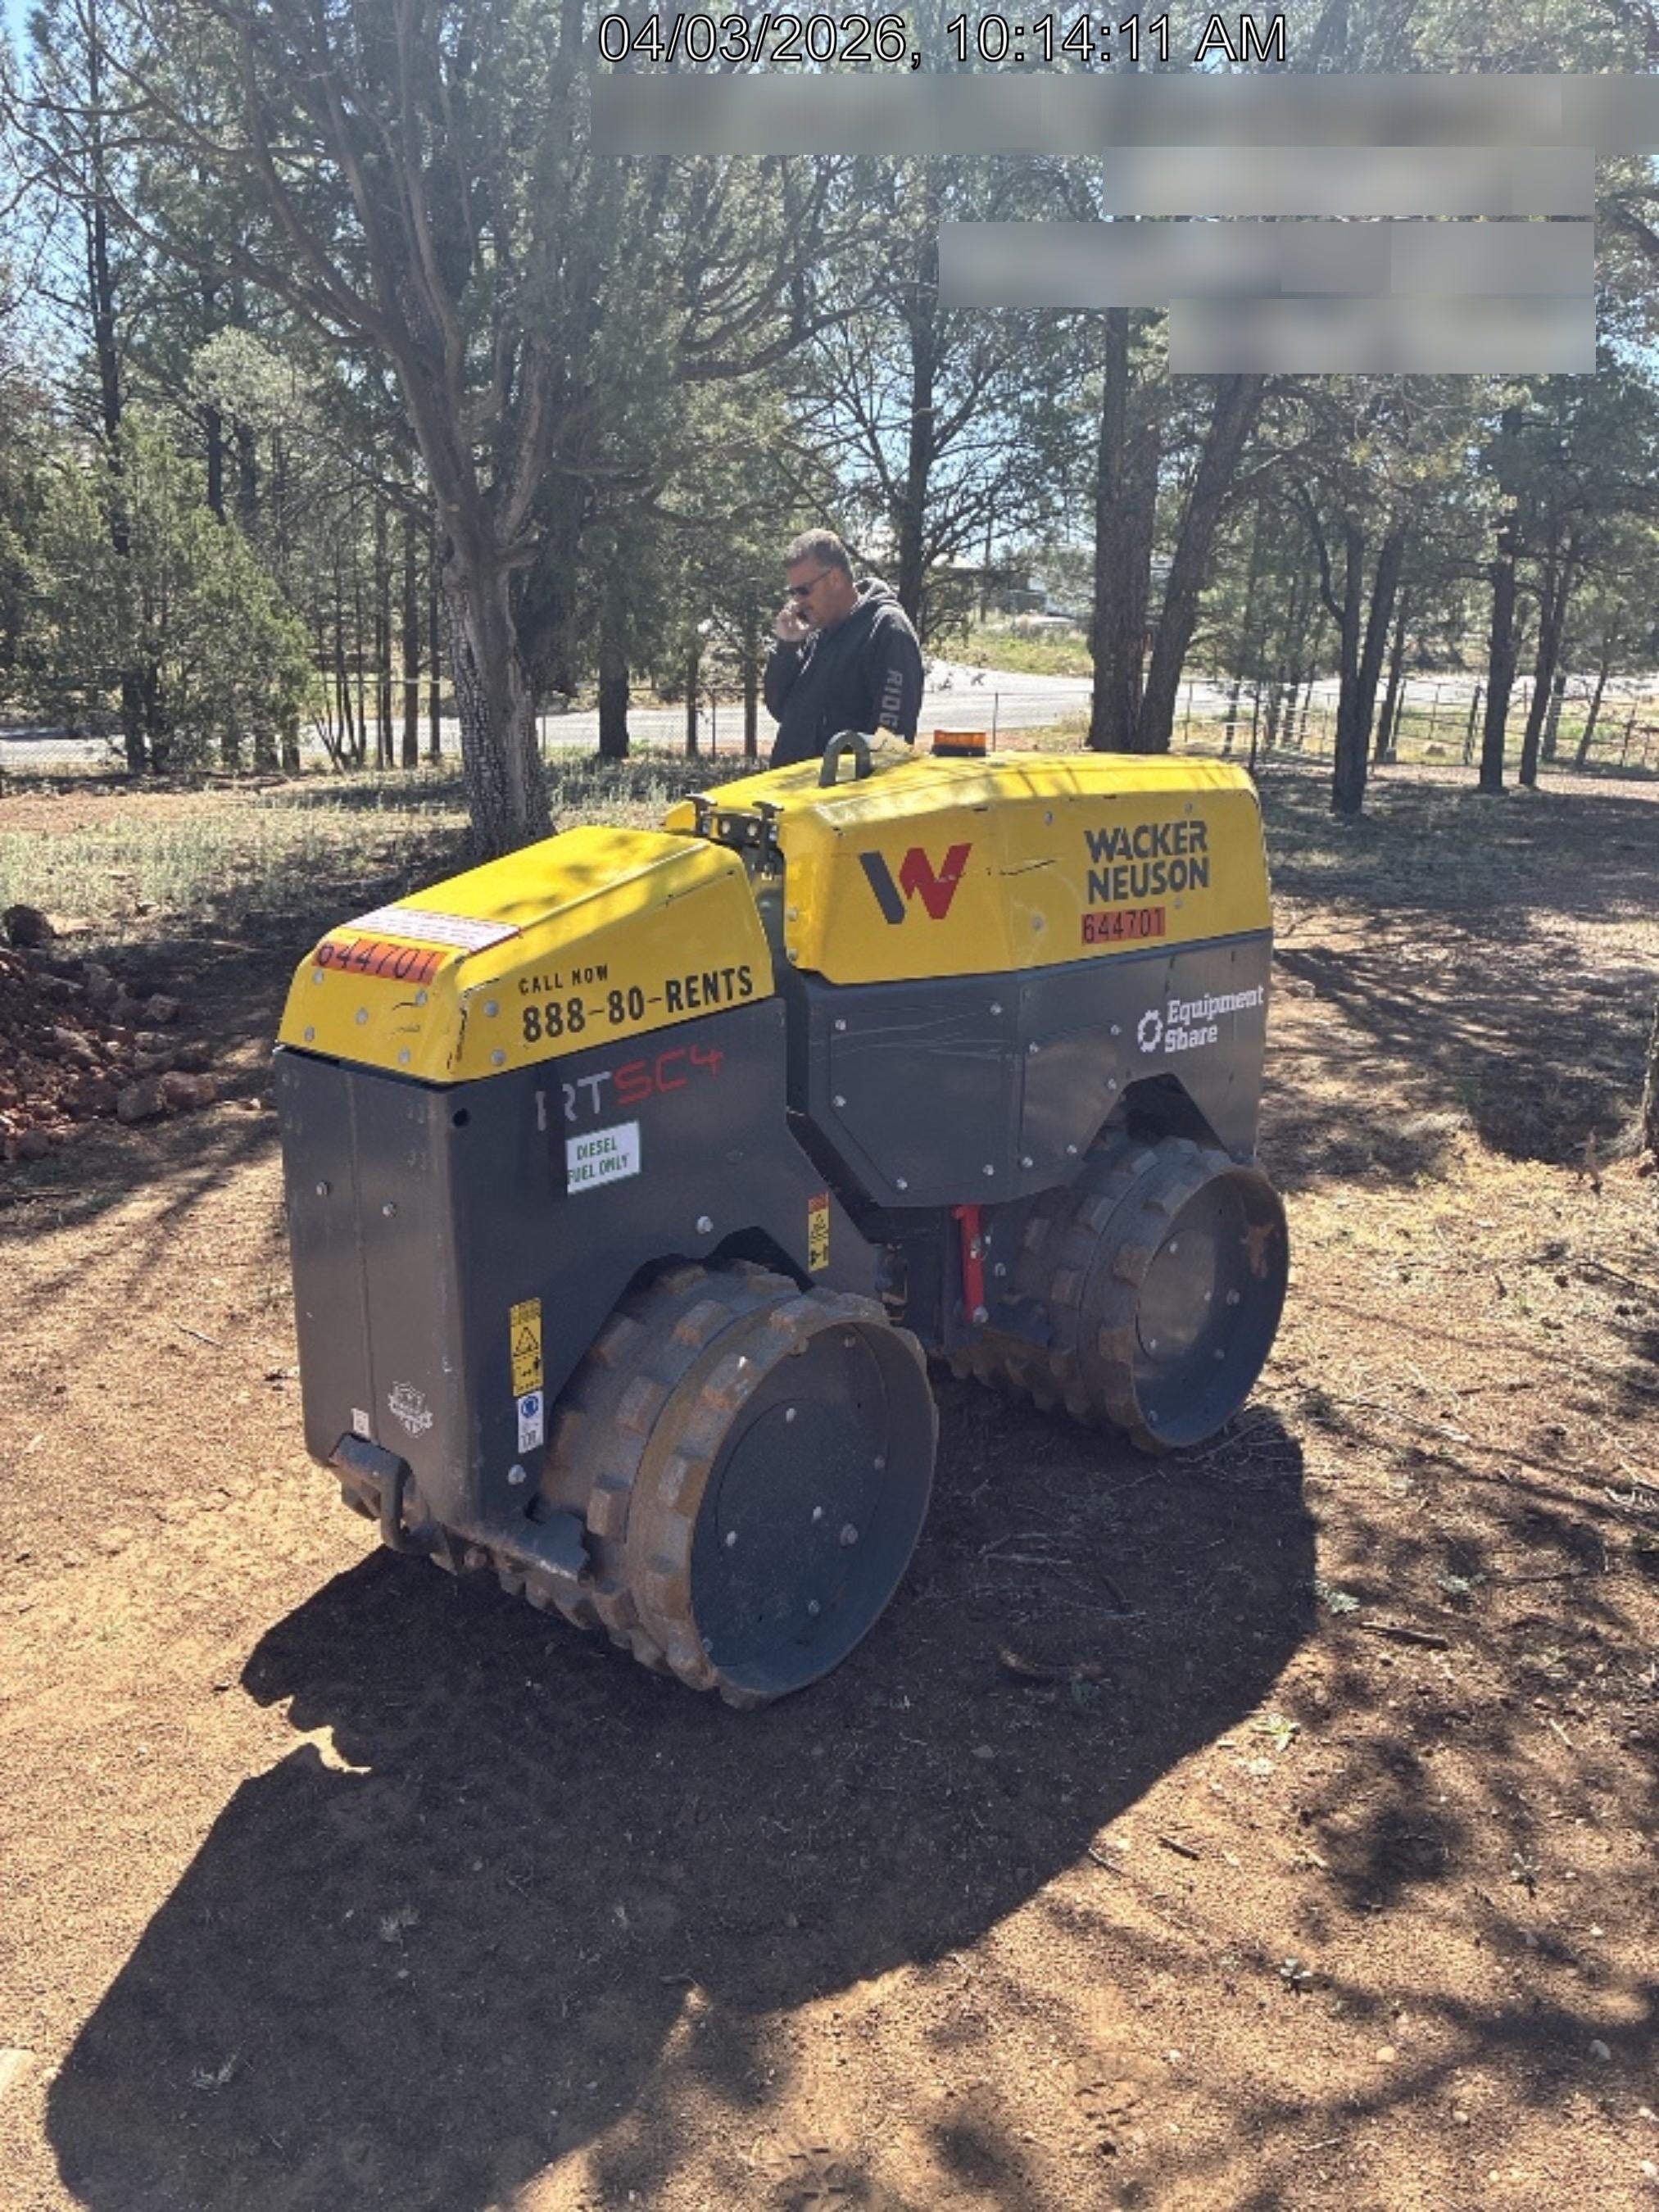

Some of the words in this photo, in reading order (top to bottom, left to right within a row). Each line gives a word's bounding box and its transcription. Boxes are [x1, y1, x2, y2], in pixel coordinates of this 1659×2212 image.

[1084, 820, 1208, 863] WACKER
[1088, 857, 1209, 904] NEUSON
[1083, 909, 1163, 944] 644701
[518, 972, 564, 995] CALL
[571, 963, 609, 986] NOW
[523, 965, 754, 1043] 888-80-RENTS
[1167, 984, 1265, 1025] Equipment
[1164, 1024, 1218, 1054] Share
[576, 1136, 618, 1161] DIESEL
[567, 1163, 596, 1185] FUEL
[599, 1152, 630, 1175] ONLY
